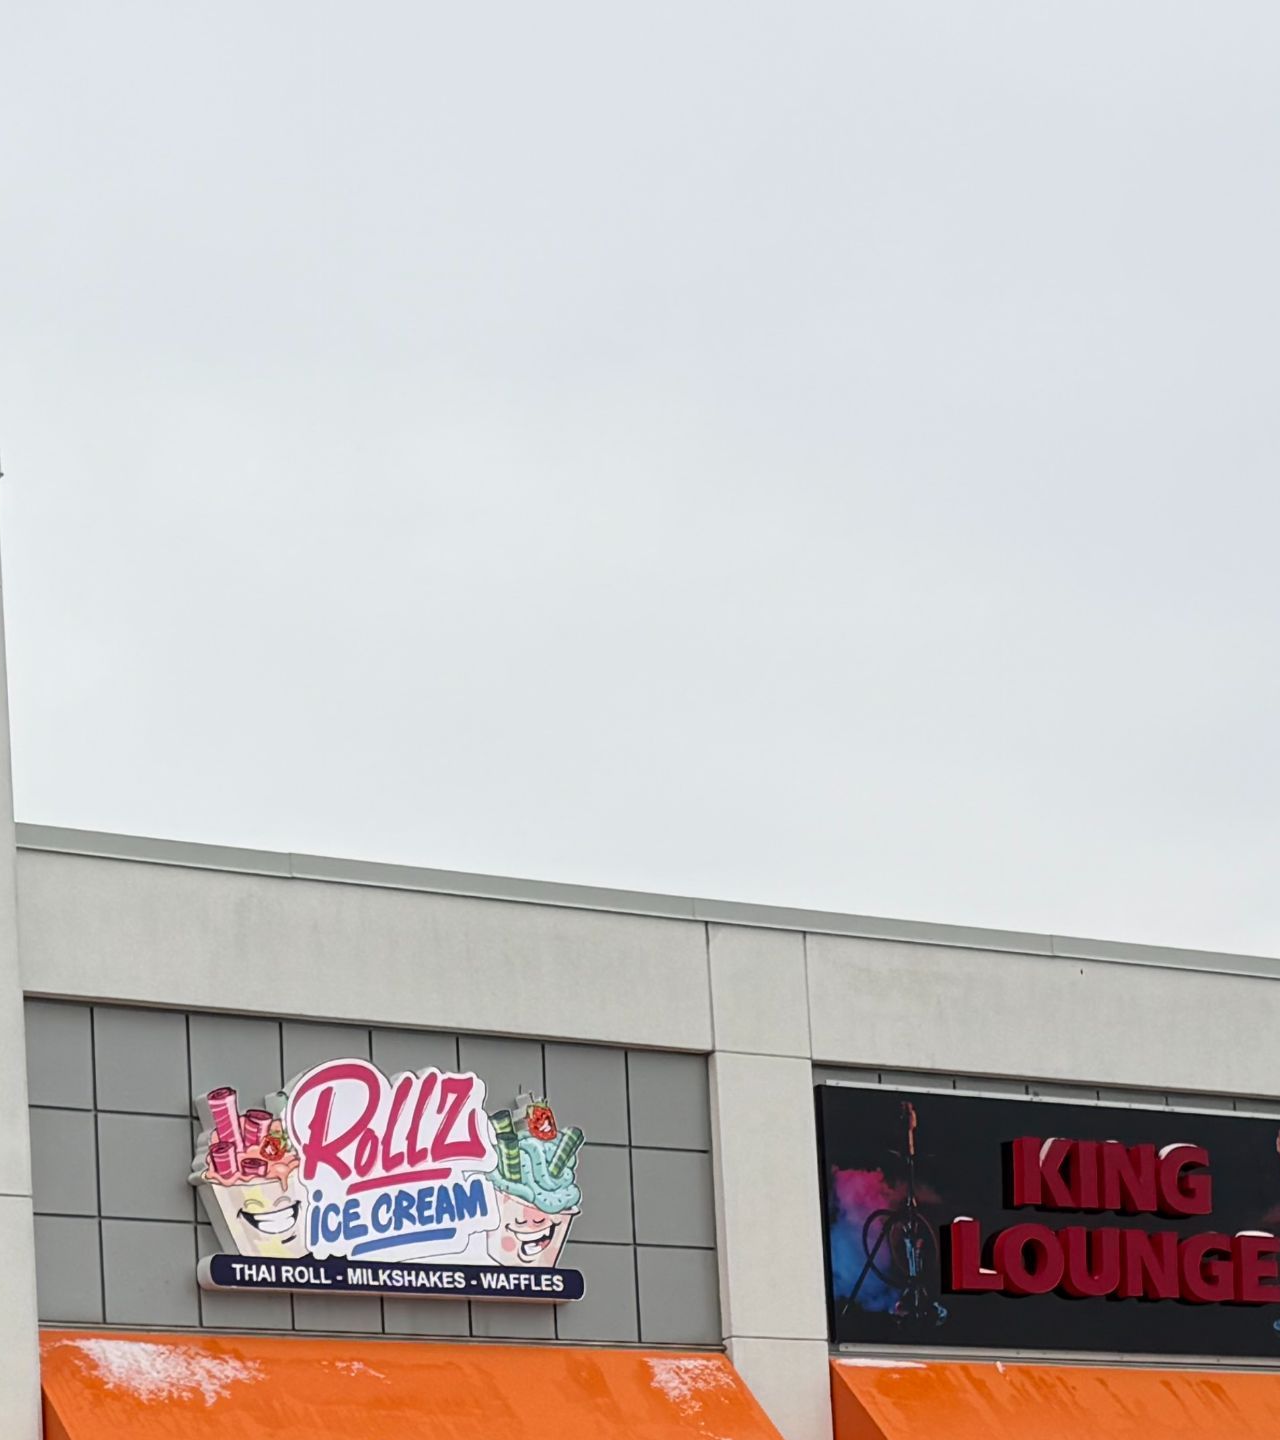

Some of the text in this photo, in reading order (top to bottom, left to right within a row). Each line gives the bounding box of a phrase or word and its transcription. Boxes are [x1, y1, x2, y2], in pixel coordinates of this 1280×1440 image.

[1013, 1137, 1213, 1216] KING
[370, 1179, 488, 1235] CREAM
[232, 1263, 276, 1283] THAI
[281, 1267, 331, 1285] ROLL
[347, 1268, 465, 1289] MILKSHAKES
[479, 1272, 565, 1292] WAFFLES
